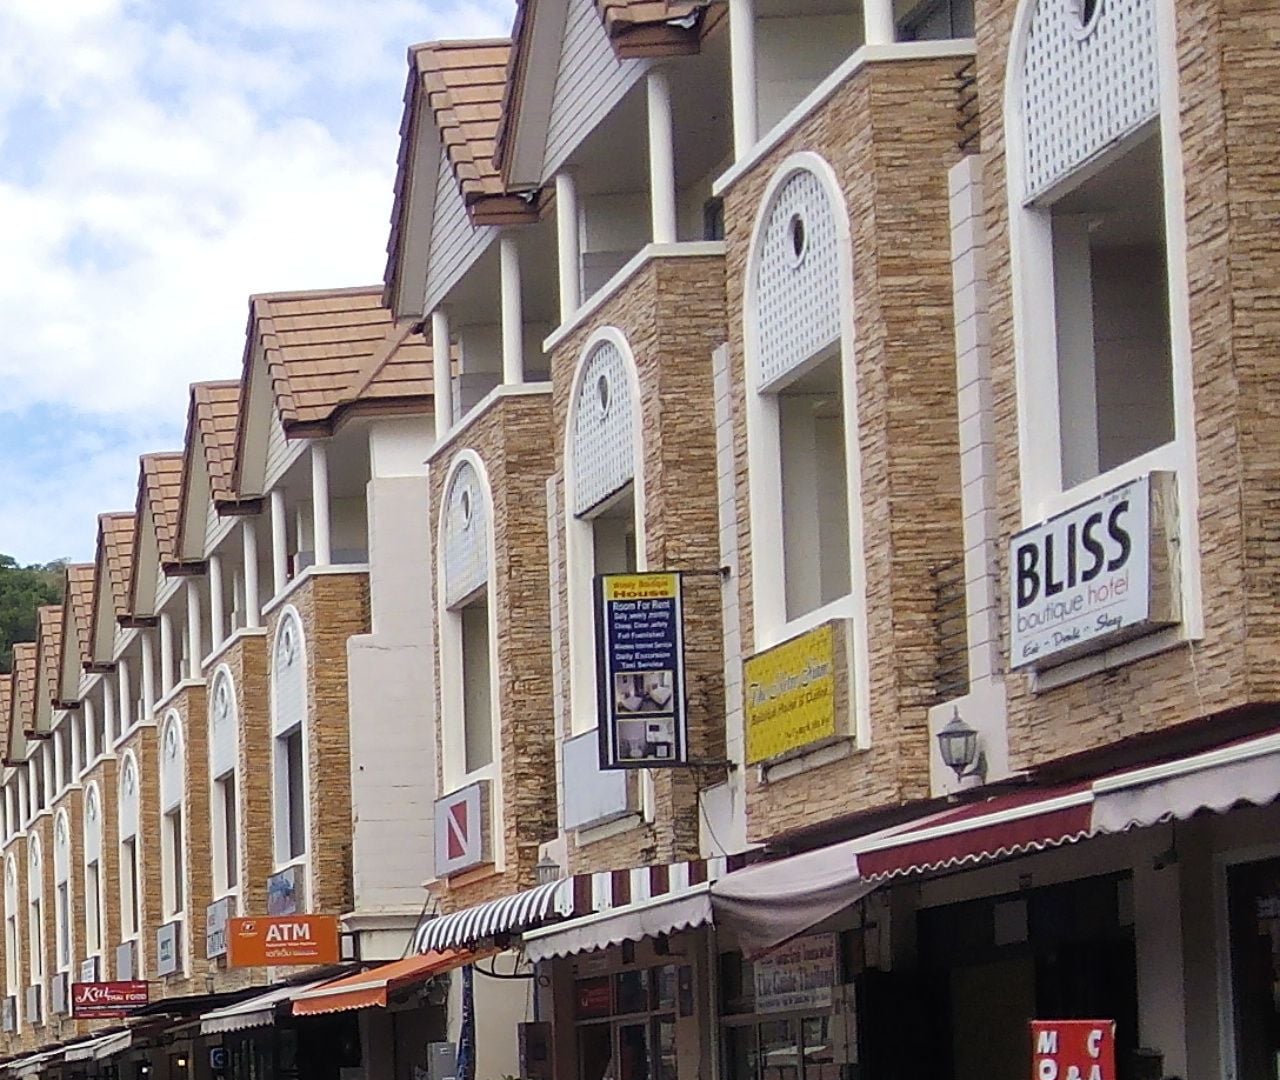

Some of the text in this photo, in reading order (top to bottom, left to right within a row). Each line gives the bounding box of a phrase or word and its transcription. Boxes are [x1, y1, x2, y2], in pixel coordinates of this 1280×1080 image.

[1017, 500, 1132, 609] BLISS
[613, 600, 670, 610] Room For Rent
[1017, 569, 1129, 633] boutique hotel
[266, 923, 310, 941] ATM
